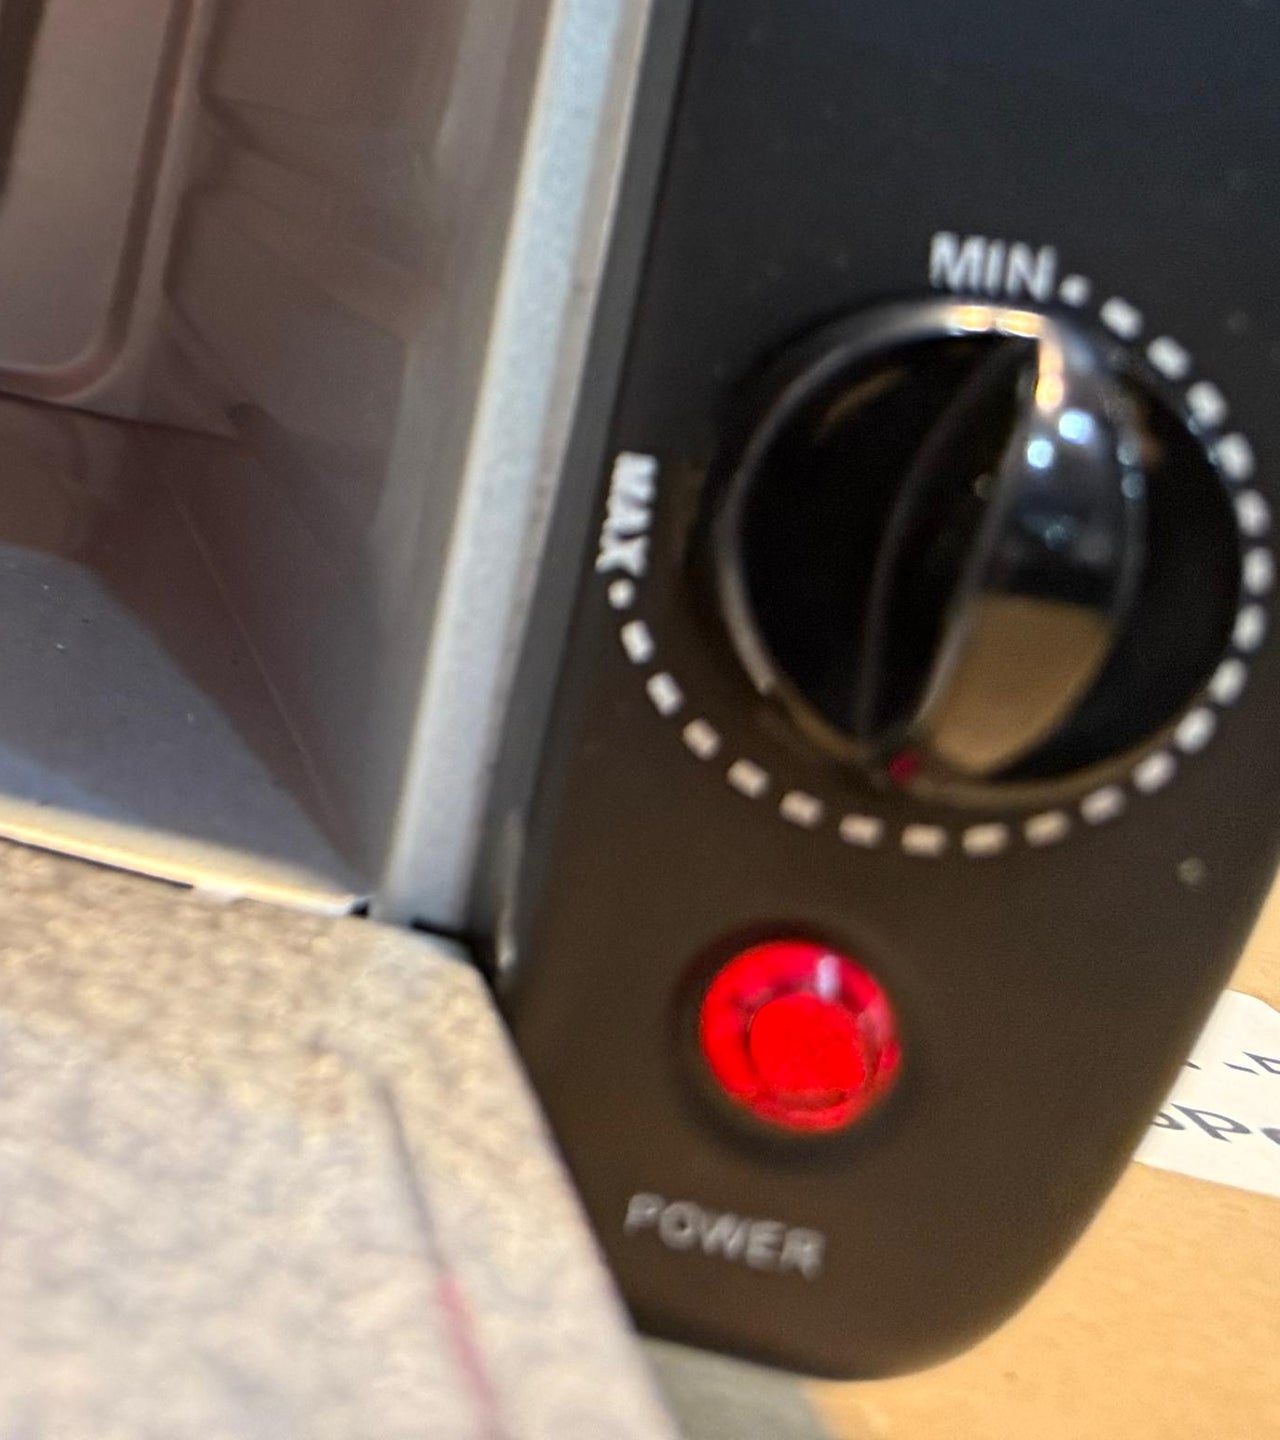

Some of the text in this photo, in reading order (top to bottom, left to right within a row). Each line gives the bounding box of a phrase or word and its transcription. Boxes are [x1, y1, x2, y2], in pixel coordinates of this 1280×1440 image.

[928, 230, 1057, 301] MIN
[595, 450, 658, 575] MAX
[623, 1191, 828, 1279] POWER
